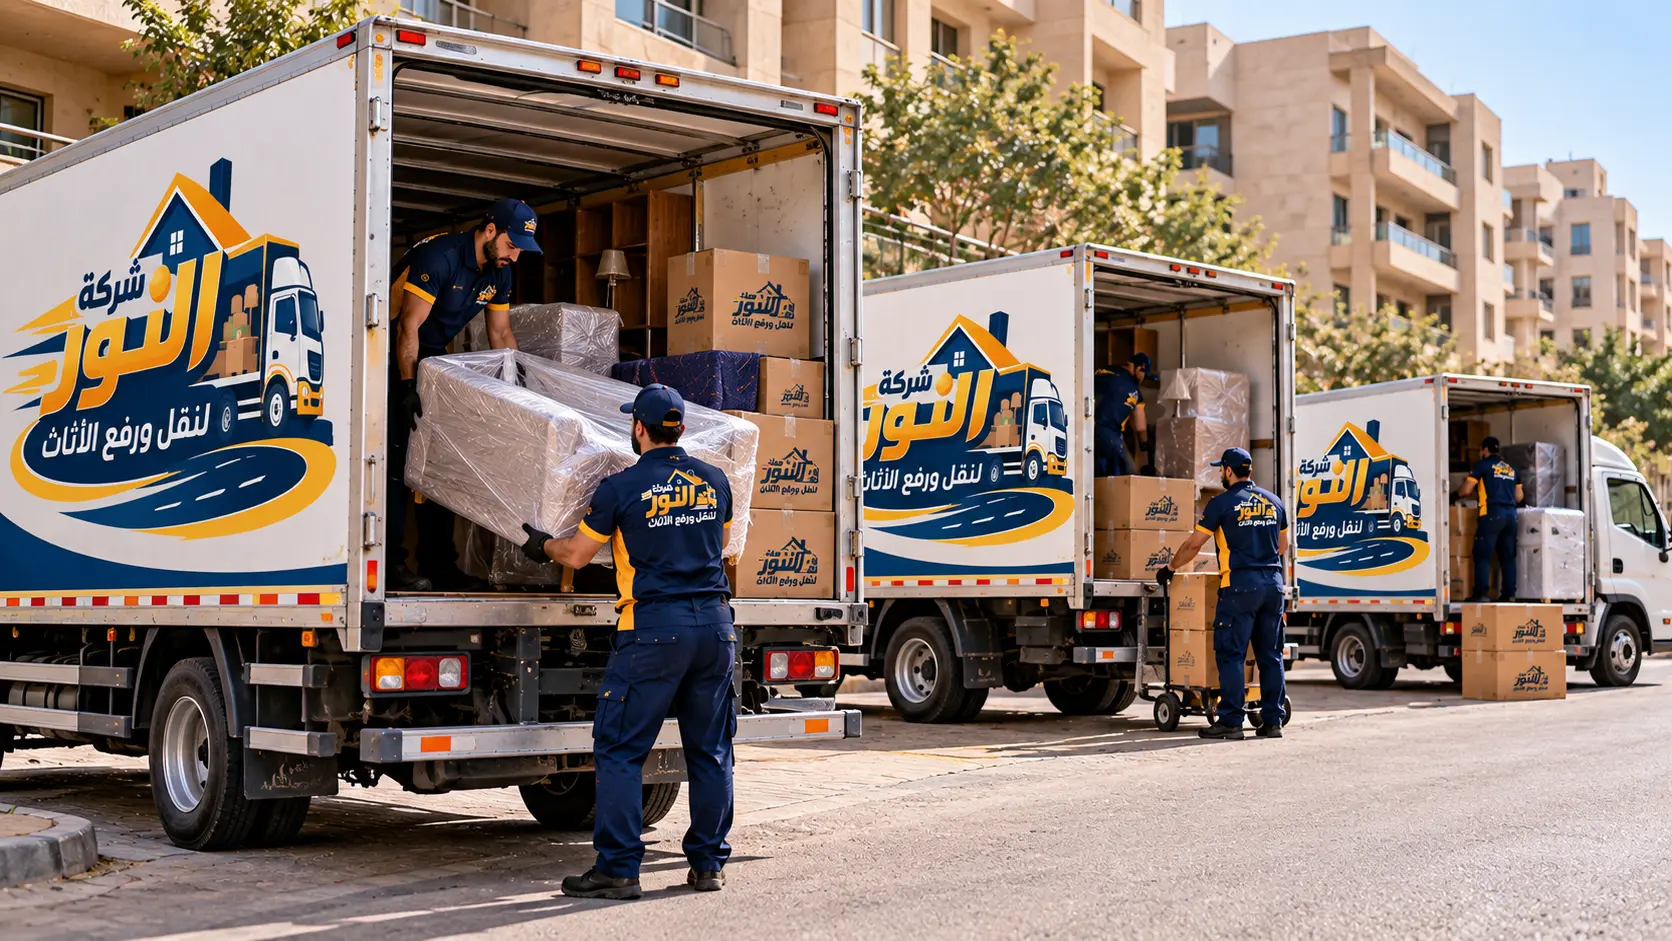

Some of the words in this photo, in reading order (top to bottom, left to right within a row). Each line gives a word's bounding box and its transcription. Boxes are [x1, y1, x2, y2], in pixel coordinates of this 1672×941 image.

[78, 257, 146, 315] شركة
[39, 250, 223, 417] النور
[878, 365, 933, 400] شركة
[41, 417, 99, 458] الأثاث
[102, 415, 153, 461] ورفع
[157, 403, 211, 450] لنقل
[901, 467, 940, 496] ورفع
[942, 462, 982, 490] لنقل
[1299, 455, 1331, 477] شركة
[645, 485, 695, 519] النور
[1296, 457, 1370, 519] النو
[1312, 522, 1336, 540] ورفع
